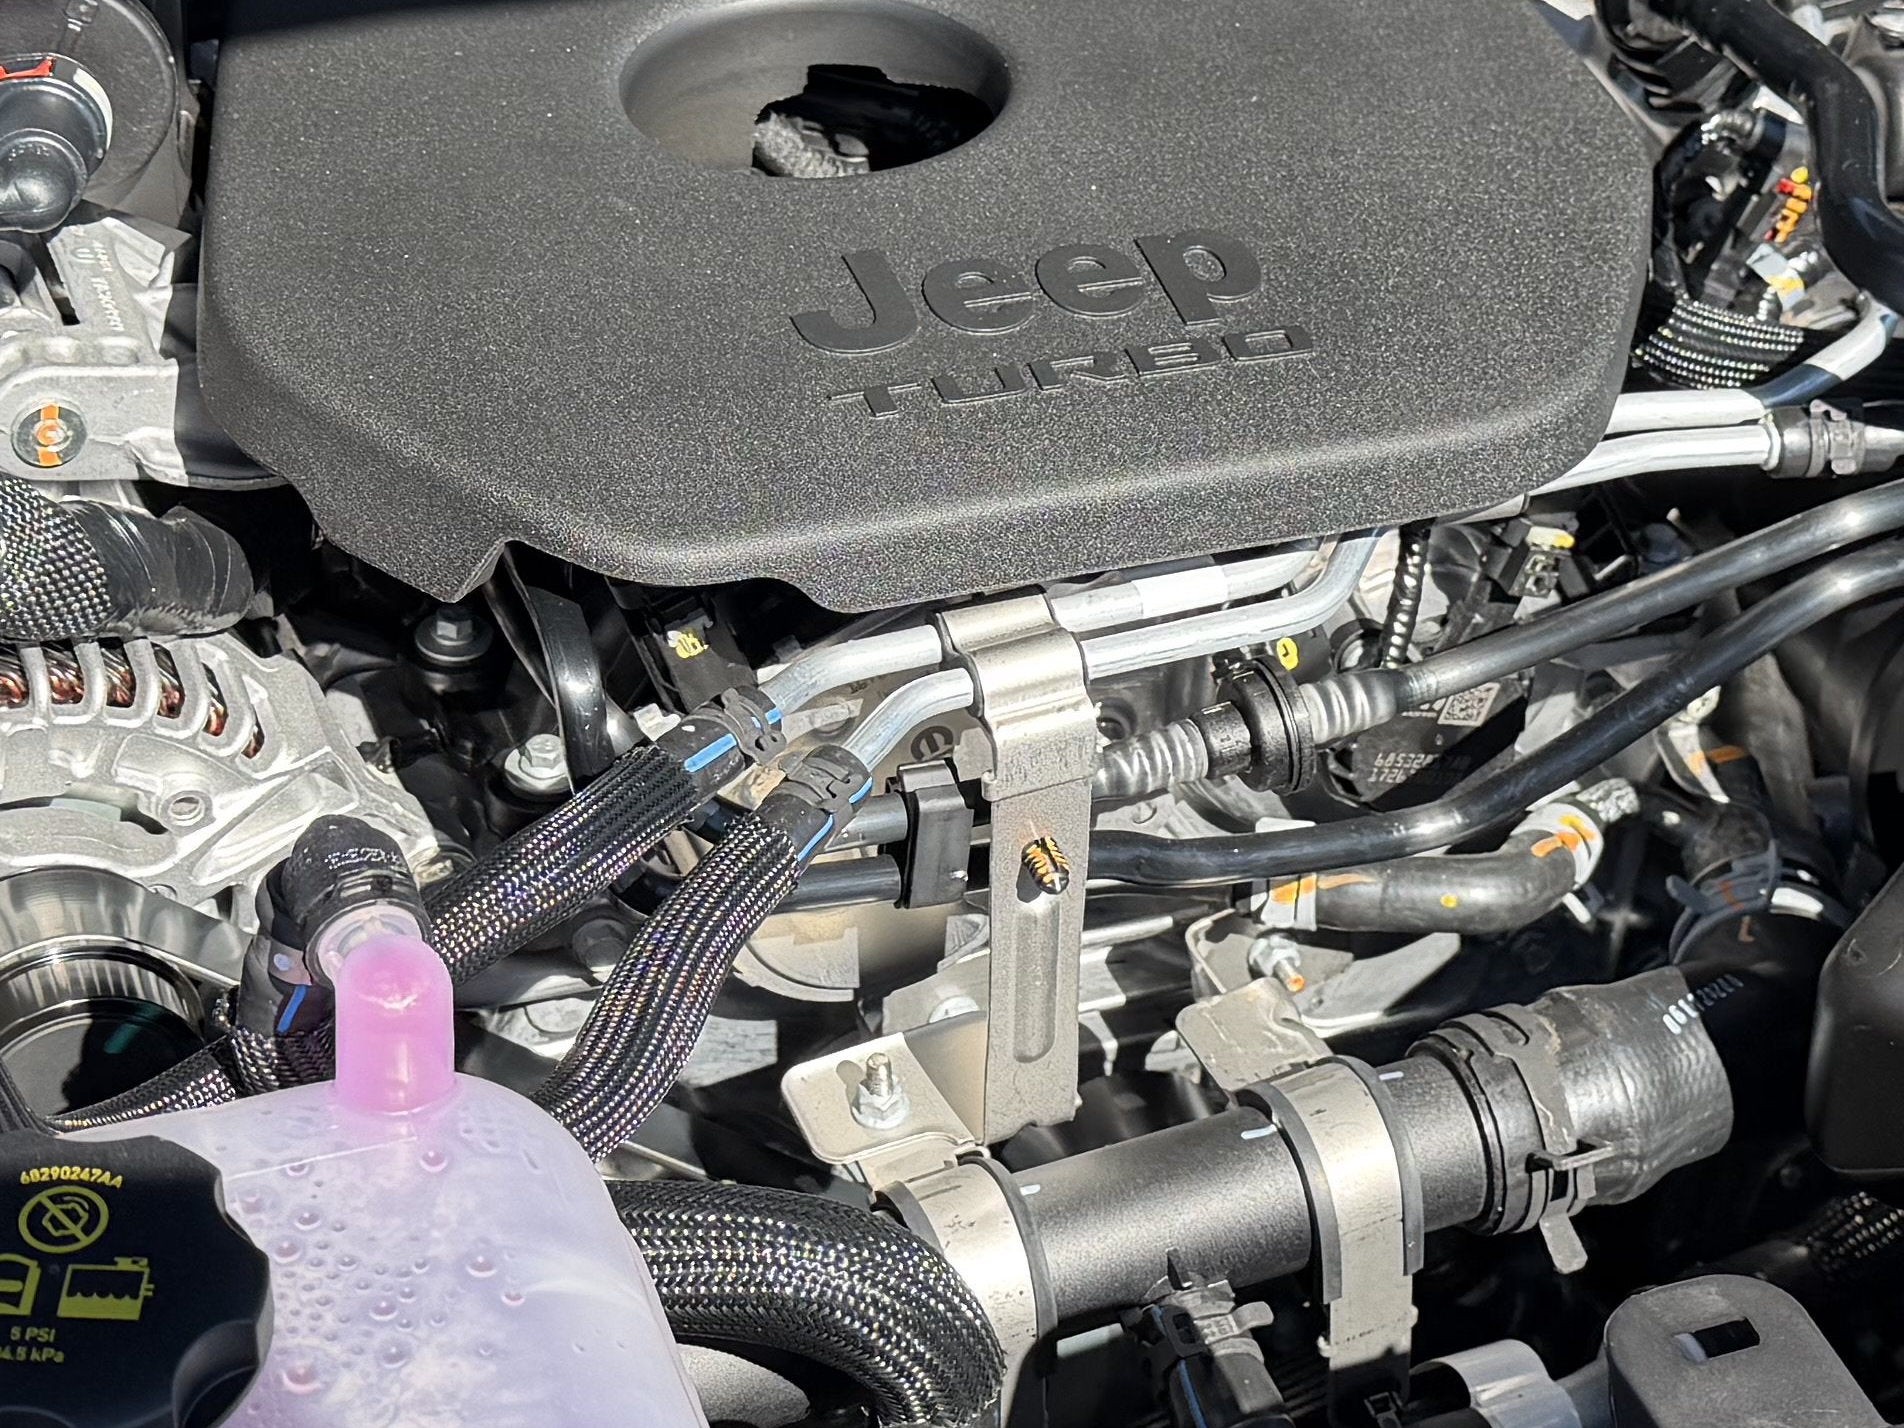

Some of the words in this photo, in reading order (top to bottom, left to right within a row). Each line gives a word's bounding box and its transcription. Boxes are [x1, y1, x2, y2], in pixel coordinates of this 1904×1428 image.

[789, 232, 1264, 356] Jeep
[827, 324, 1314, 419] TURBO
[24, 1326, 56, 1343] PSI
[30, 1346, 65, 1364] kPa
